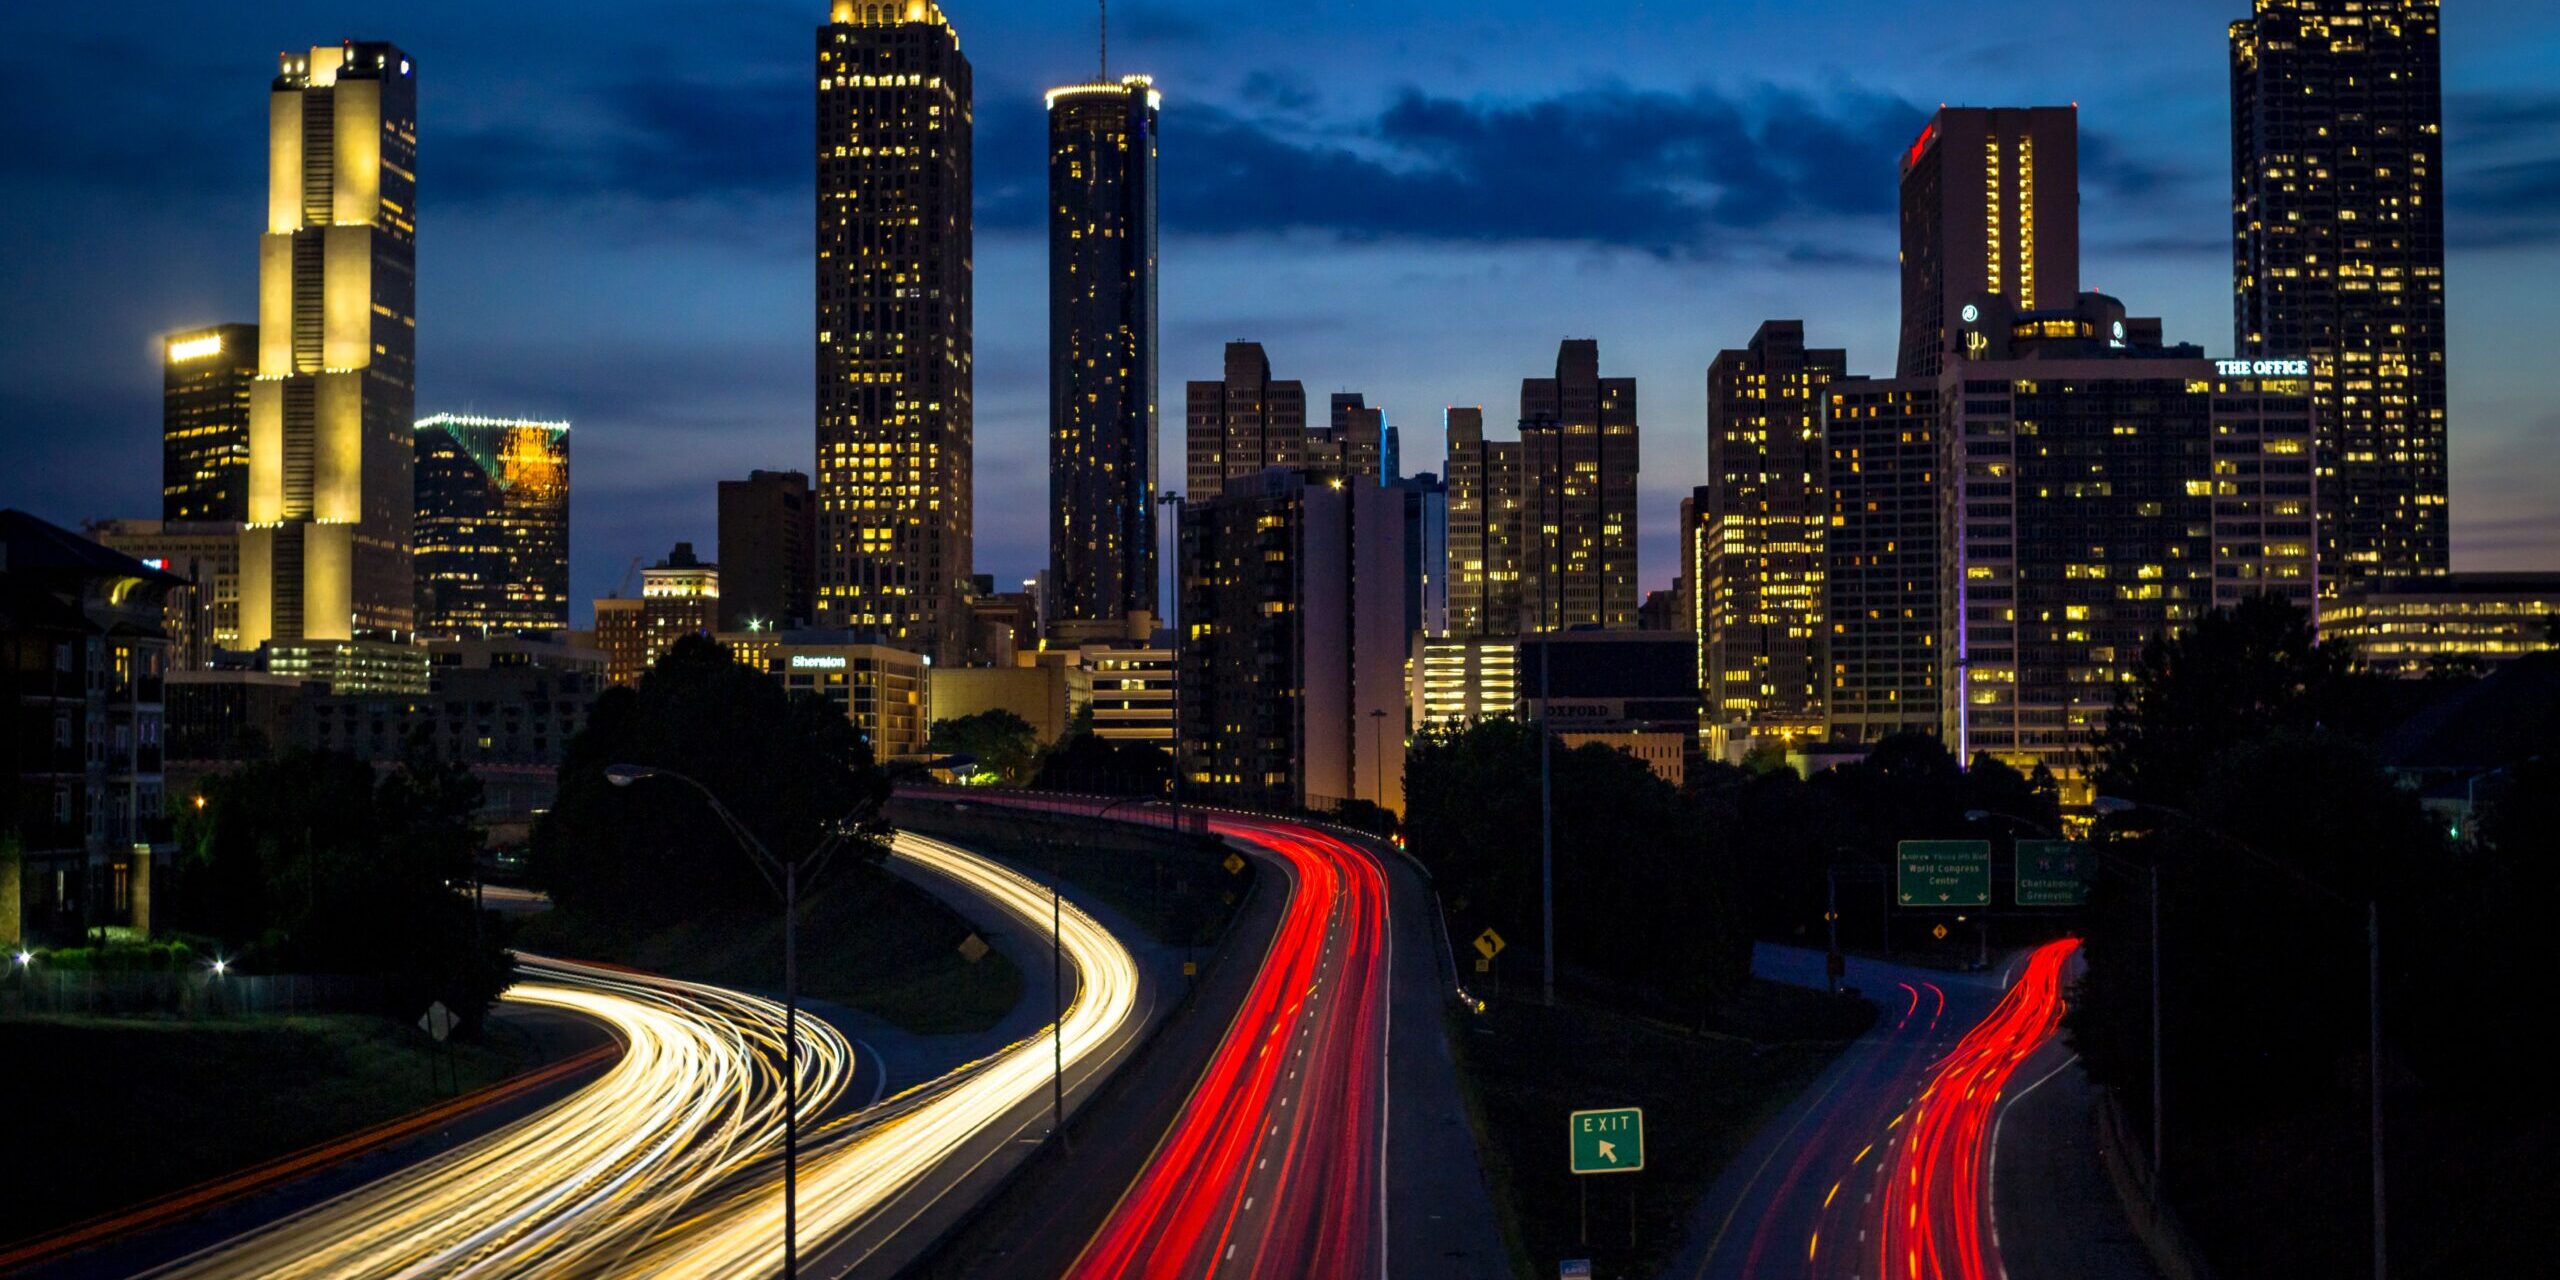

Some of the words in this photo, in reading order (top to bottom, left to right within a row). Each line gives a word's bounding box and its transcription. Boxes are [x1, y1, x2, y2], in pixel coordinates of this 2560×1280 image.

[2215, 360, 2251, 375] THE
[2253, 360, 2308, 375] OFFICE
[1909, 864, 1935, 873] World
[1937, 864, 1980, 874] Congress
[1929, 876, 1959, 885] Center
[1584, 1116, 1629, 1132] EXIT
